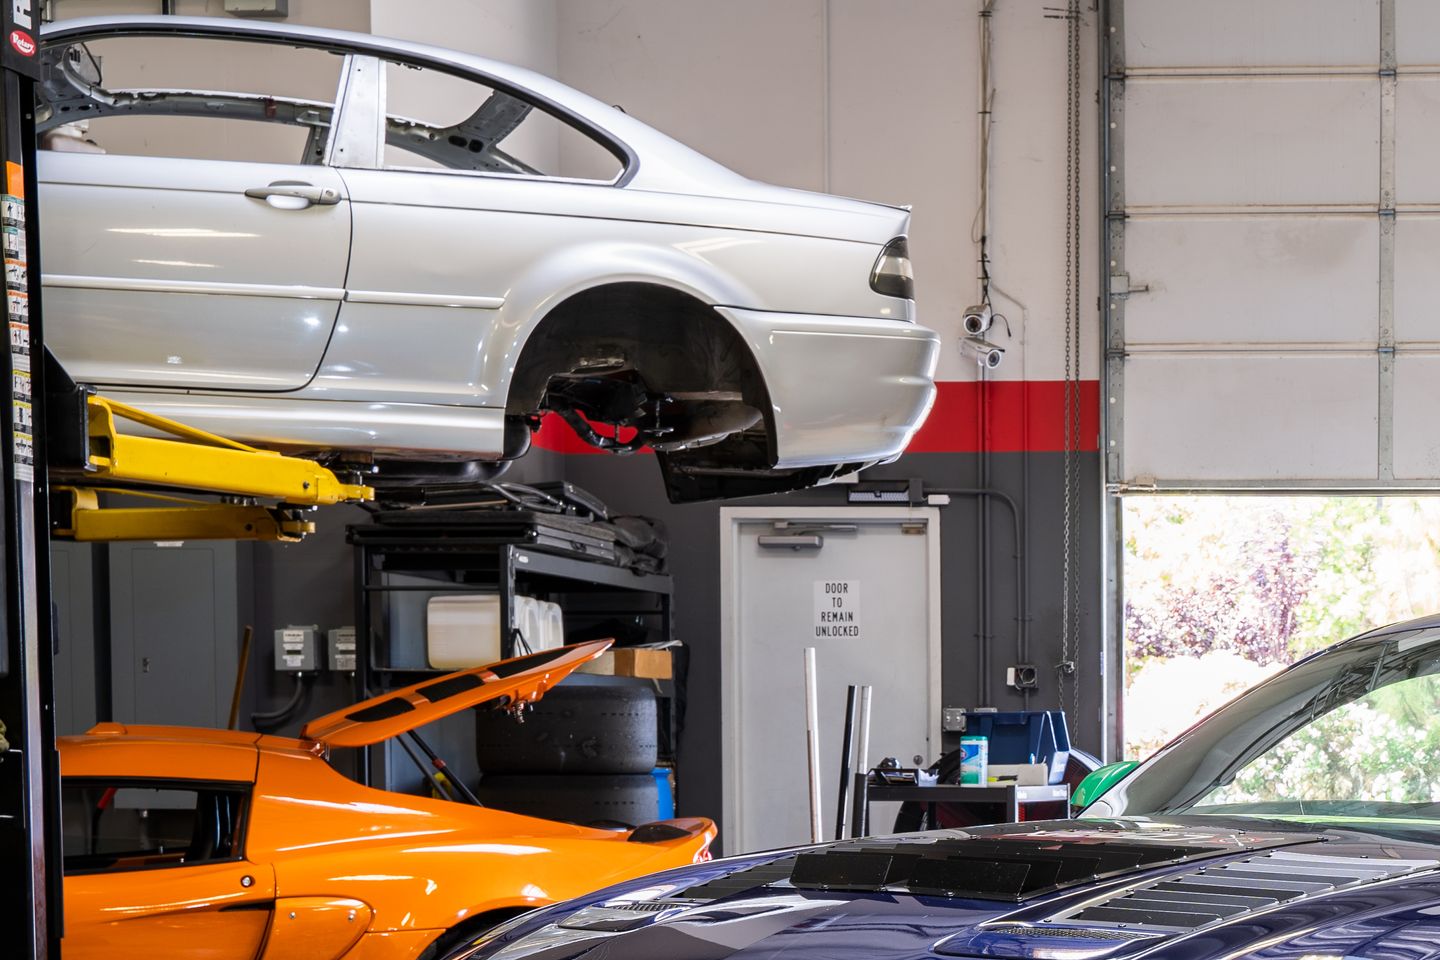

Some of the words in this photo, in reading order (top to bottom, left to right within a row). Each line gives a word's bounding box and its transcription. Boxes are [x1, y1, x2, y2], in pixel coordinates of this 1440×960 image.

[825, 582, 849, 594] DOOR
[832, 597, 843, 608] TO
[820, 611, 854, 623] REMAIN
[815, 625, 859, 637] UNLOCKED
